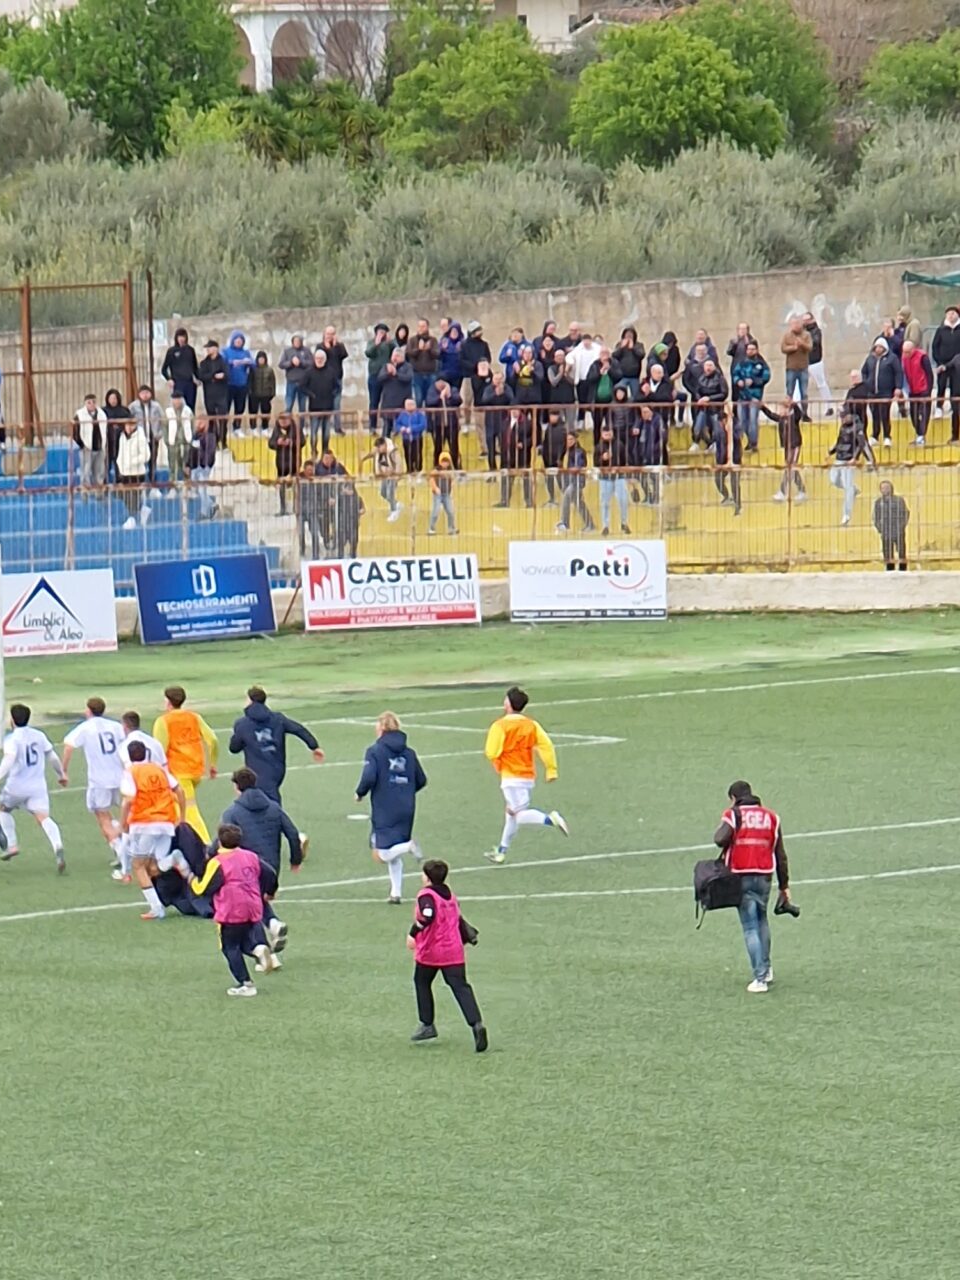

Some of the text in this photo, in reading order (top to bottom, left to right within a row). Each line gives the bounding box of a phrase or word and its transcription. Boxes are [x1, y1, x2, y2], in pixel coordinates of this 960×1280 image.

[348, 557, 472, 584] CASTELLI
[570, 557, 630, 577] Patti
[156, 593, 258, 612] TECNOSERRAMENTI
[349, 583, 475, 605] COSTRUZIONI
[25, 741, 39, 768] 15
[98, 731, 117, 755] 13
